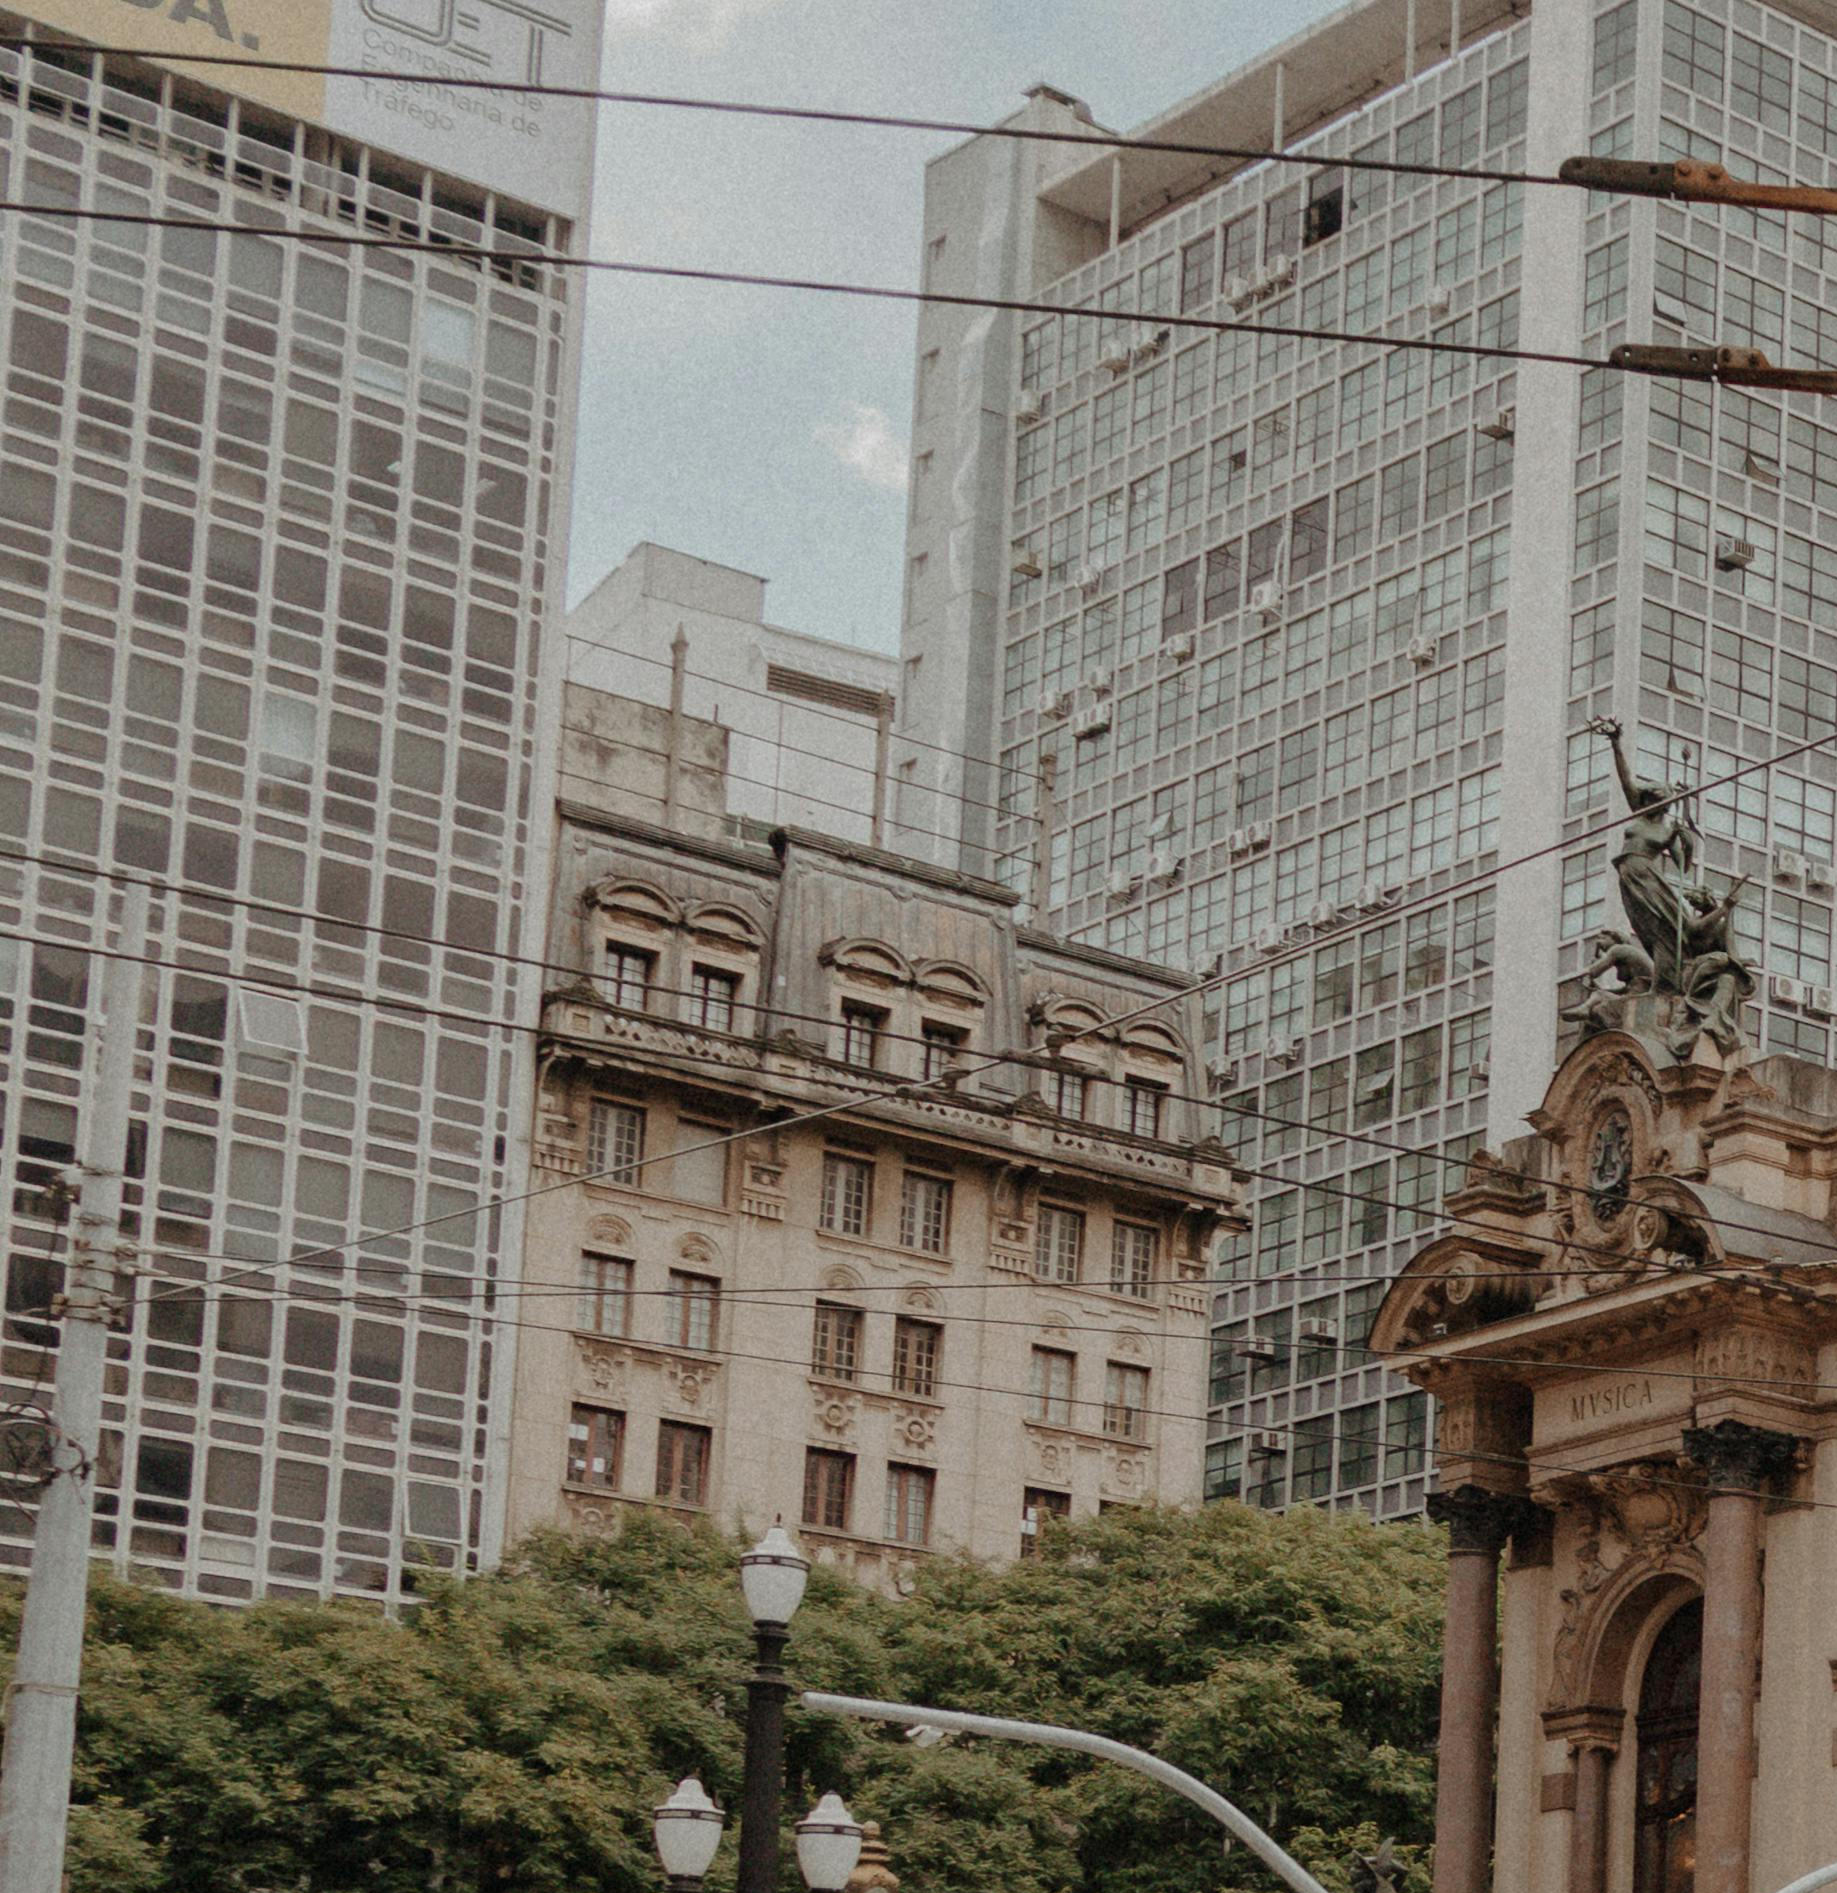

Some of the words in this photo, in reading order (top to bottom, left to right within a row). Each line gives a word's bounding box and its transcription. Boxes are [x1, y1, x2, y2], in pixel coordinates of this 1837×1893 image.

[360, 78, 454, 132] Tráfego
[511, 114, 542, 138] de
[1570, 1379, 1653, 1422] MVSICA
